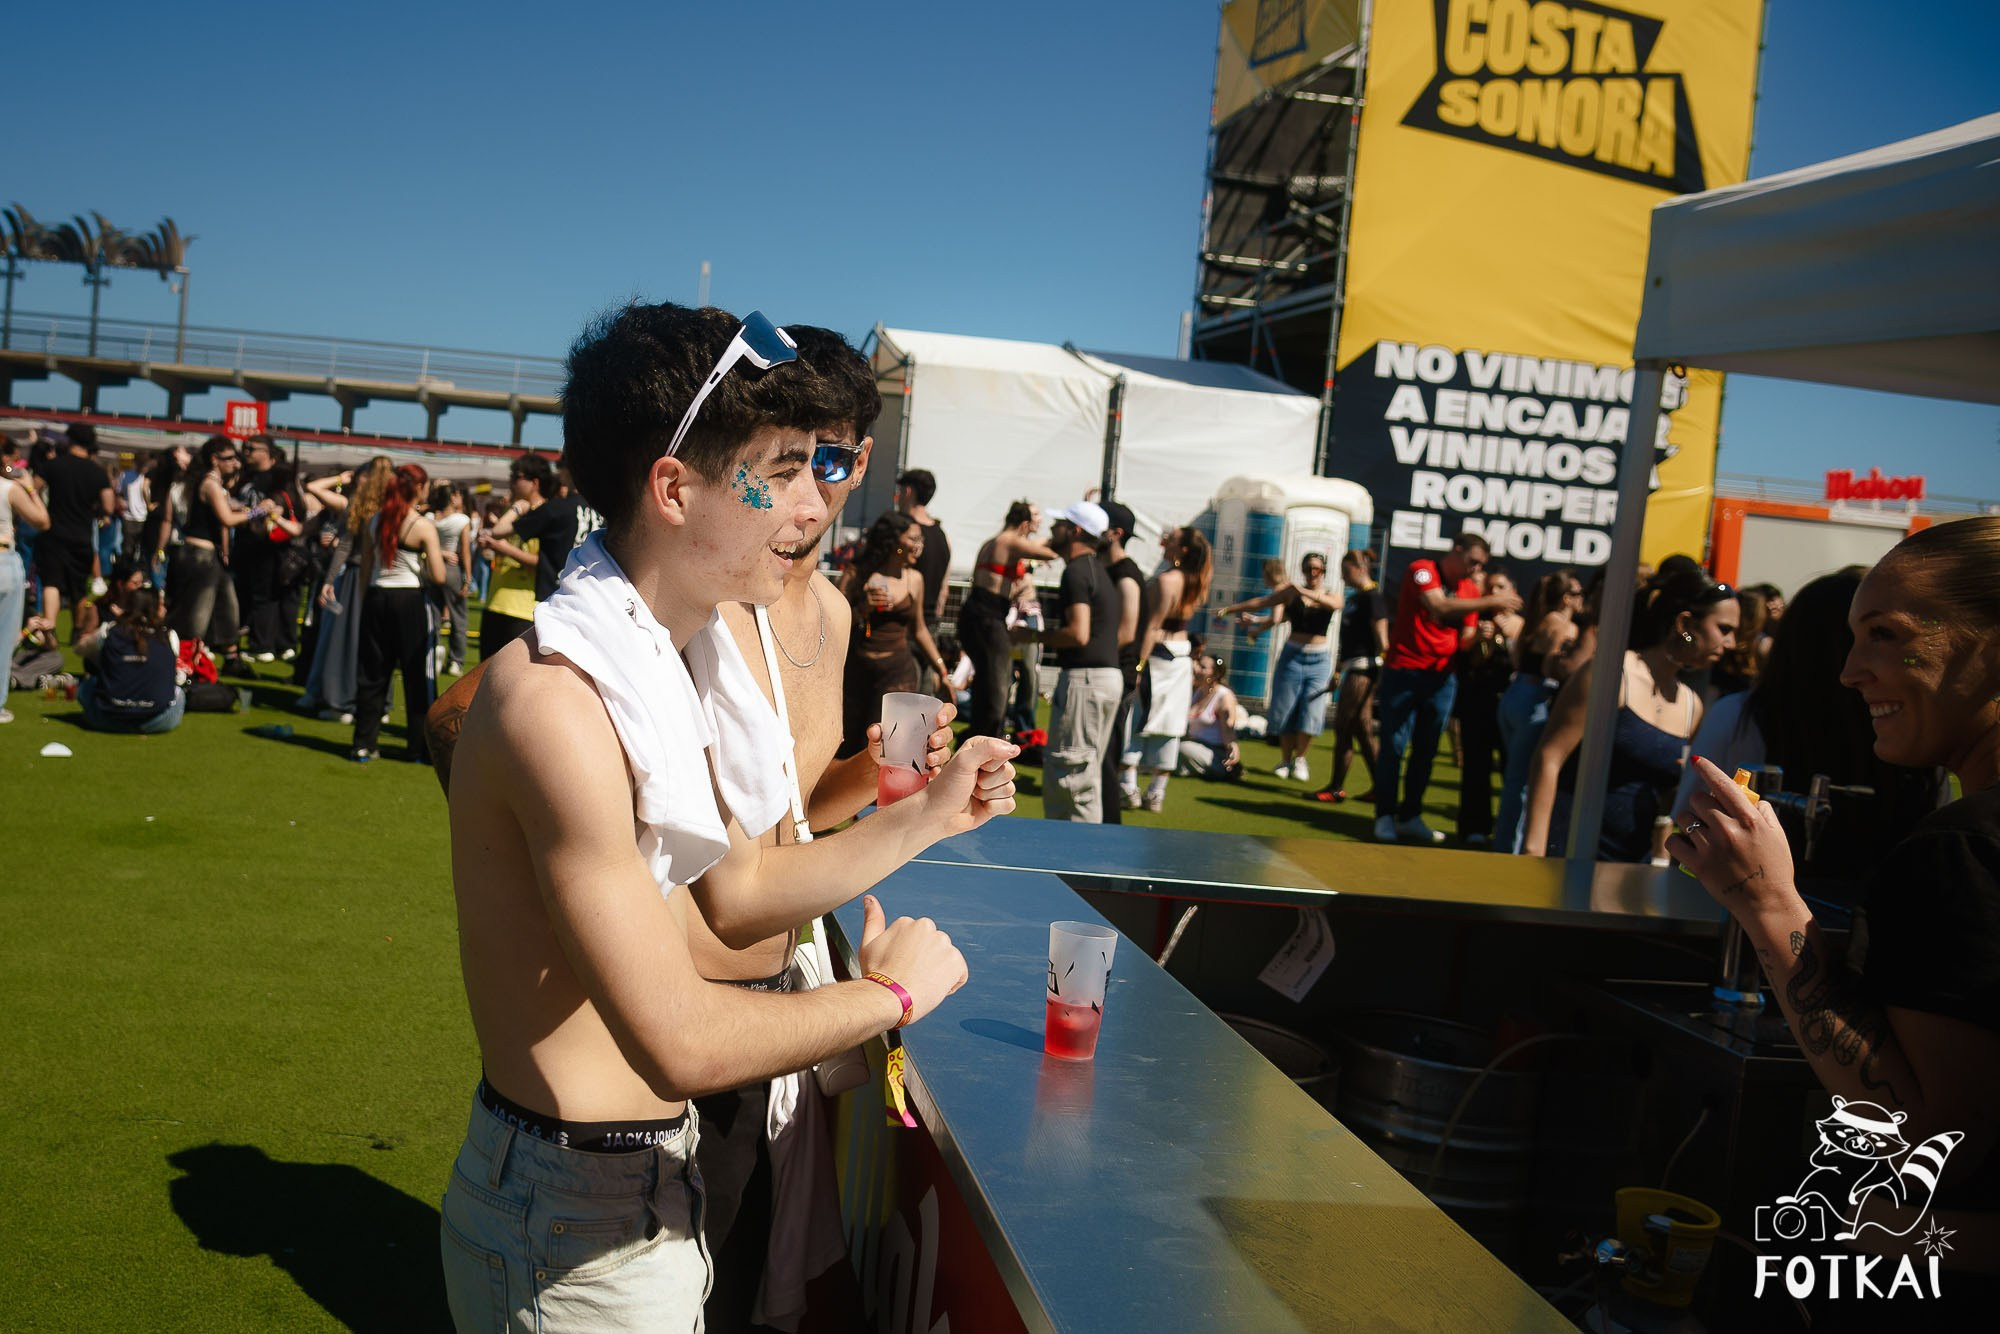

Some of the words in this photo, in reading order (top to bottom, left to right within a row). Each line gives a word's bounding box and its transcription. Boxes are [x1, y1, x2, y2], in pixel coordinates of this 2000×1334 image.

[1444, 0, 1637, 75] COSTA
[1437, 77, 1675, 178] SONORA
[1375, 340, 1457, 384] NO
[1384, 385, 1428, 424] A
[1389, 425, 1617, 485] VINIMOS
[1410, 470, 1619, 526] ROMPER
[1390, 510, 1454, 552] EL
